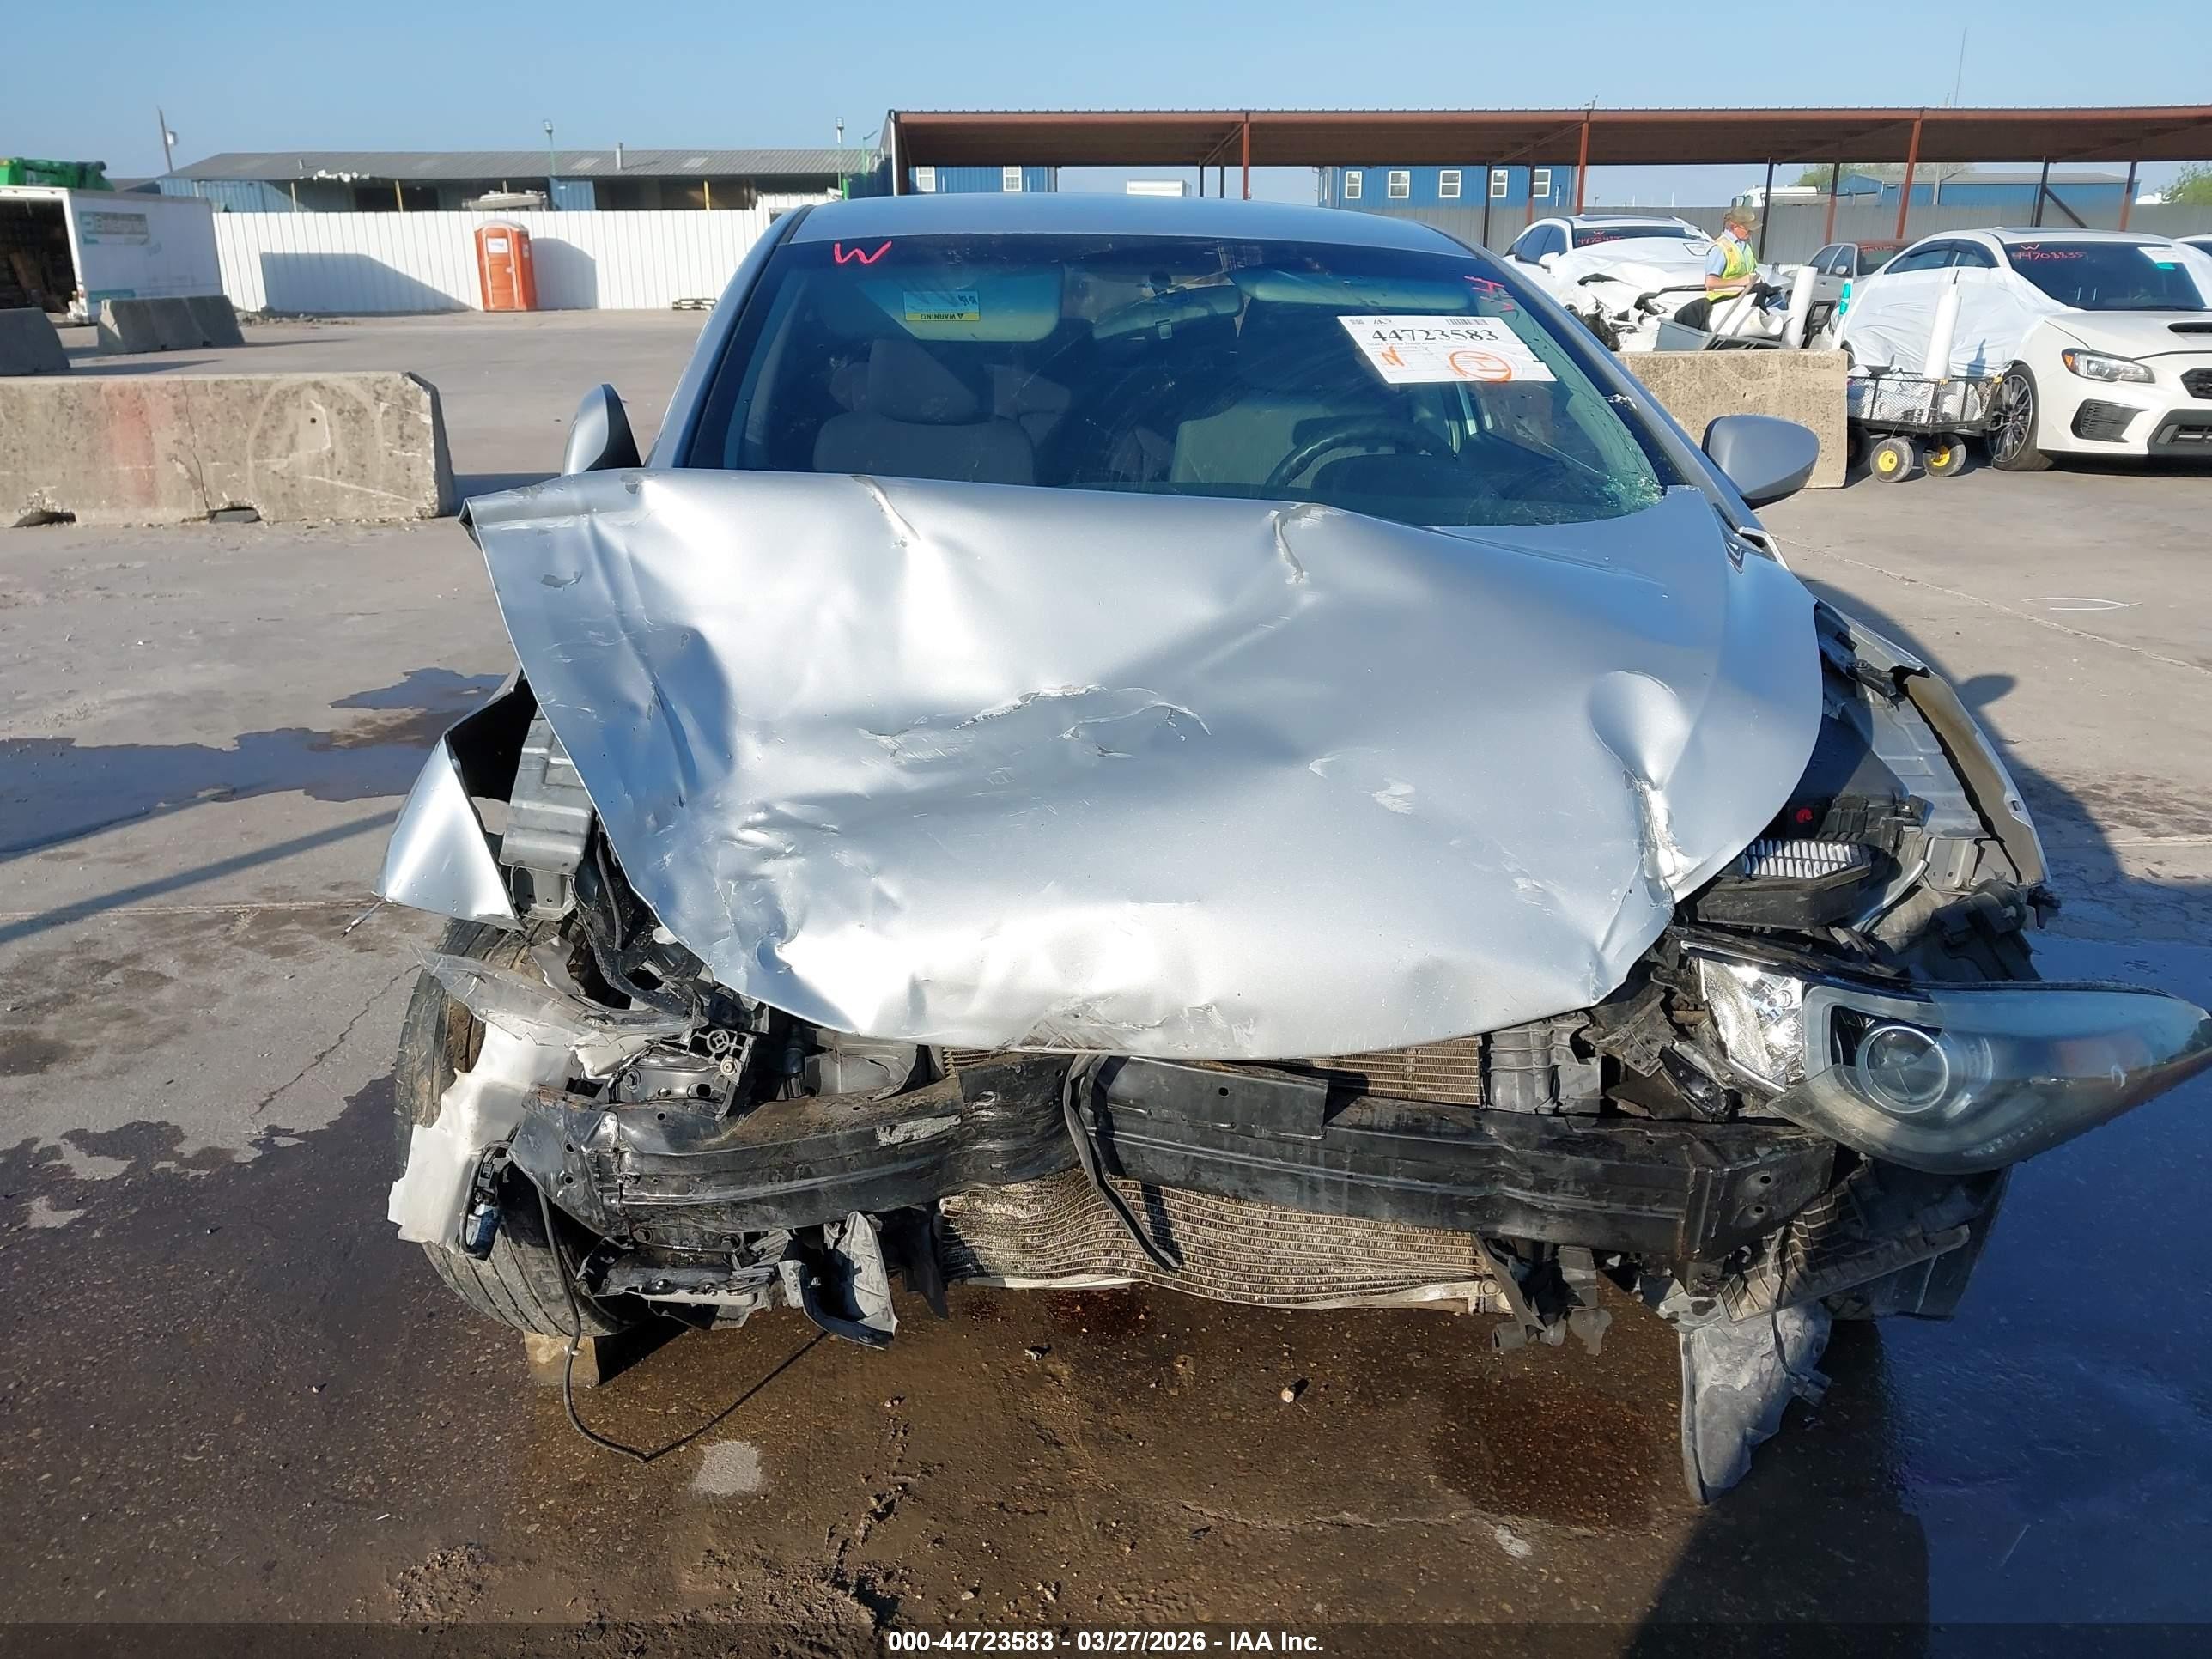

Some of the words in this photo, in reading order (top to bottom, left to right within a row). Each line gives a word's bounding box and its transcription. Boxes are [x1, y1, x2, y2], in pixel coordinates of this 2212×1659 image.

[831, 240, 893, 264] W
[920, 313, 957, 321] WARNING
[1372, 329, 1498, 342] 44723583
